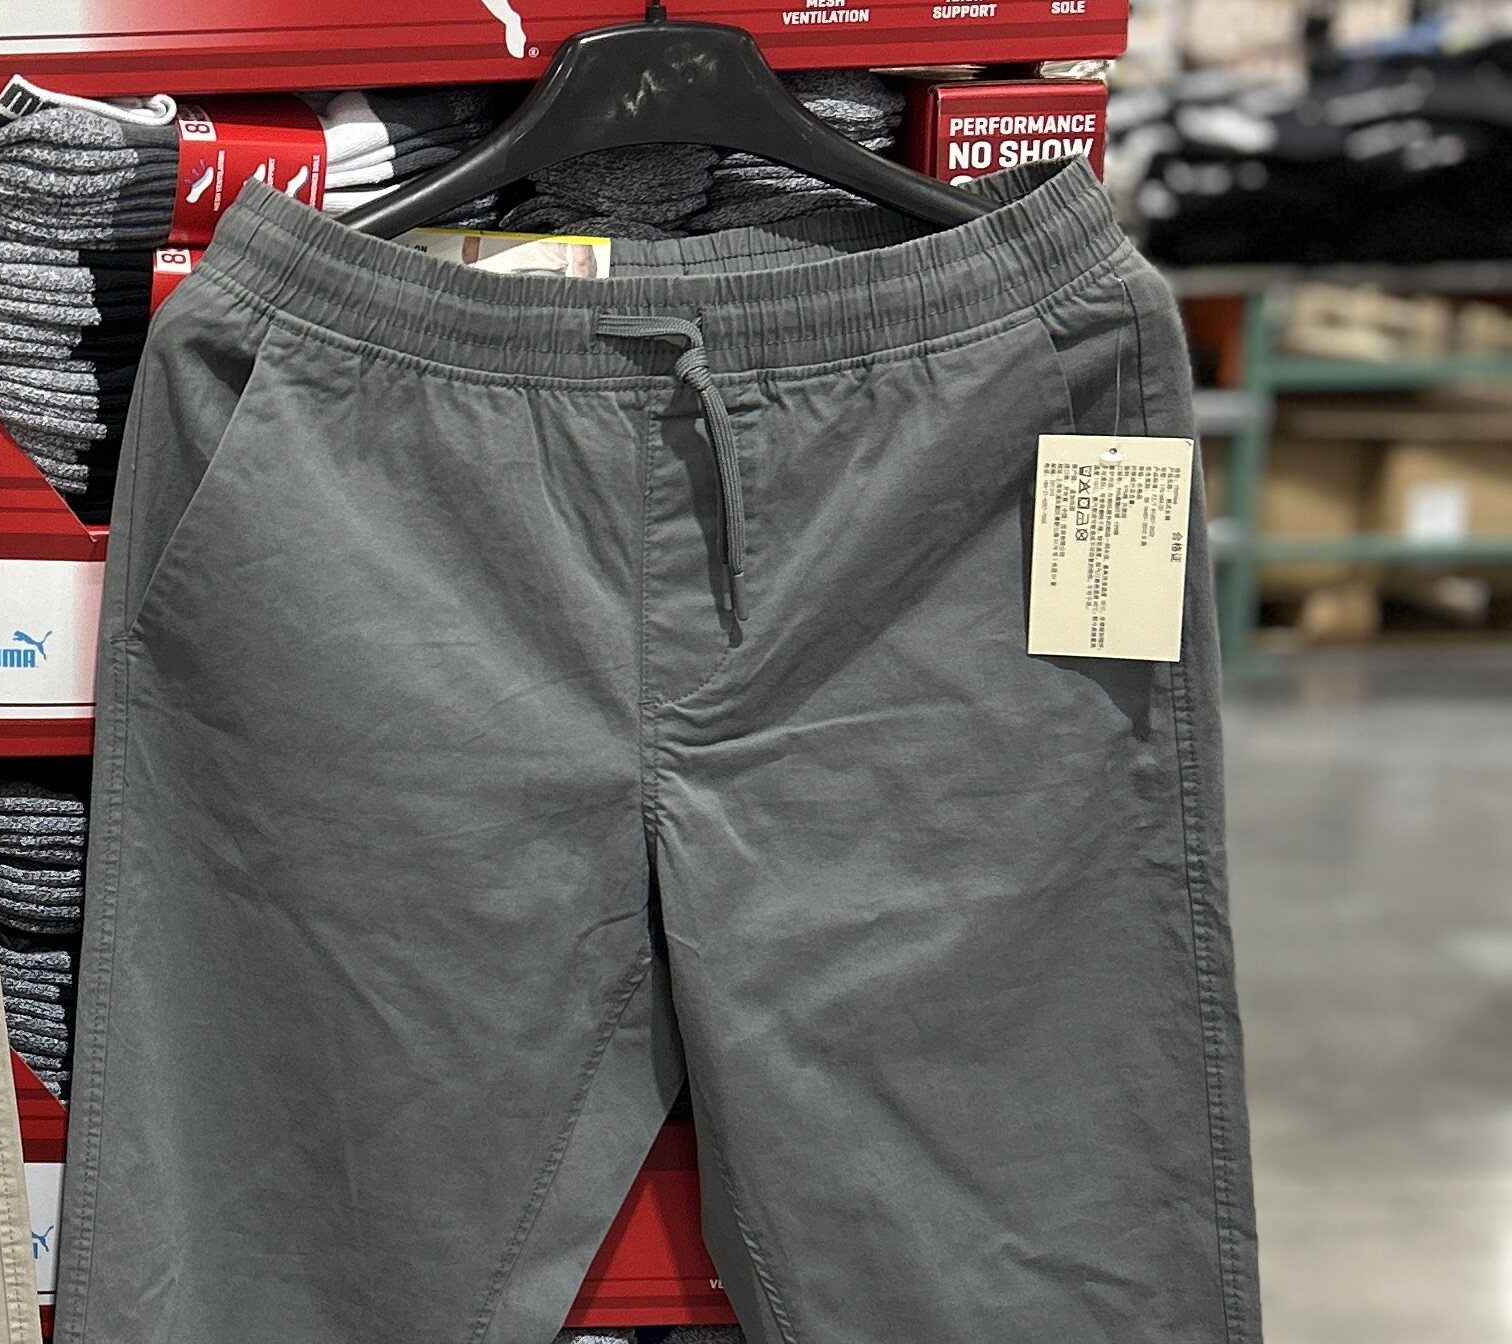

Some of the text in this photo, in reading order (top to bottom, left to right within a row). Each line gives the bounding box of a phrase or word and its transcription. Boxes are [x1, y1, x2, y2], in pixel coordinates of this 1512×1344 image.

[782, 9, 869, 25] VENTILATION
[932, 4, 997, 20] SUPPORT
[1051, 0, 1085, 15] SOLE
[950, 114, 1096, 137] PERFORMANCE
[948, 138, 1094, 170] NO SHOW
[1170, 532, 1183, 562] 合格证
